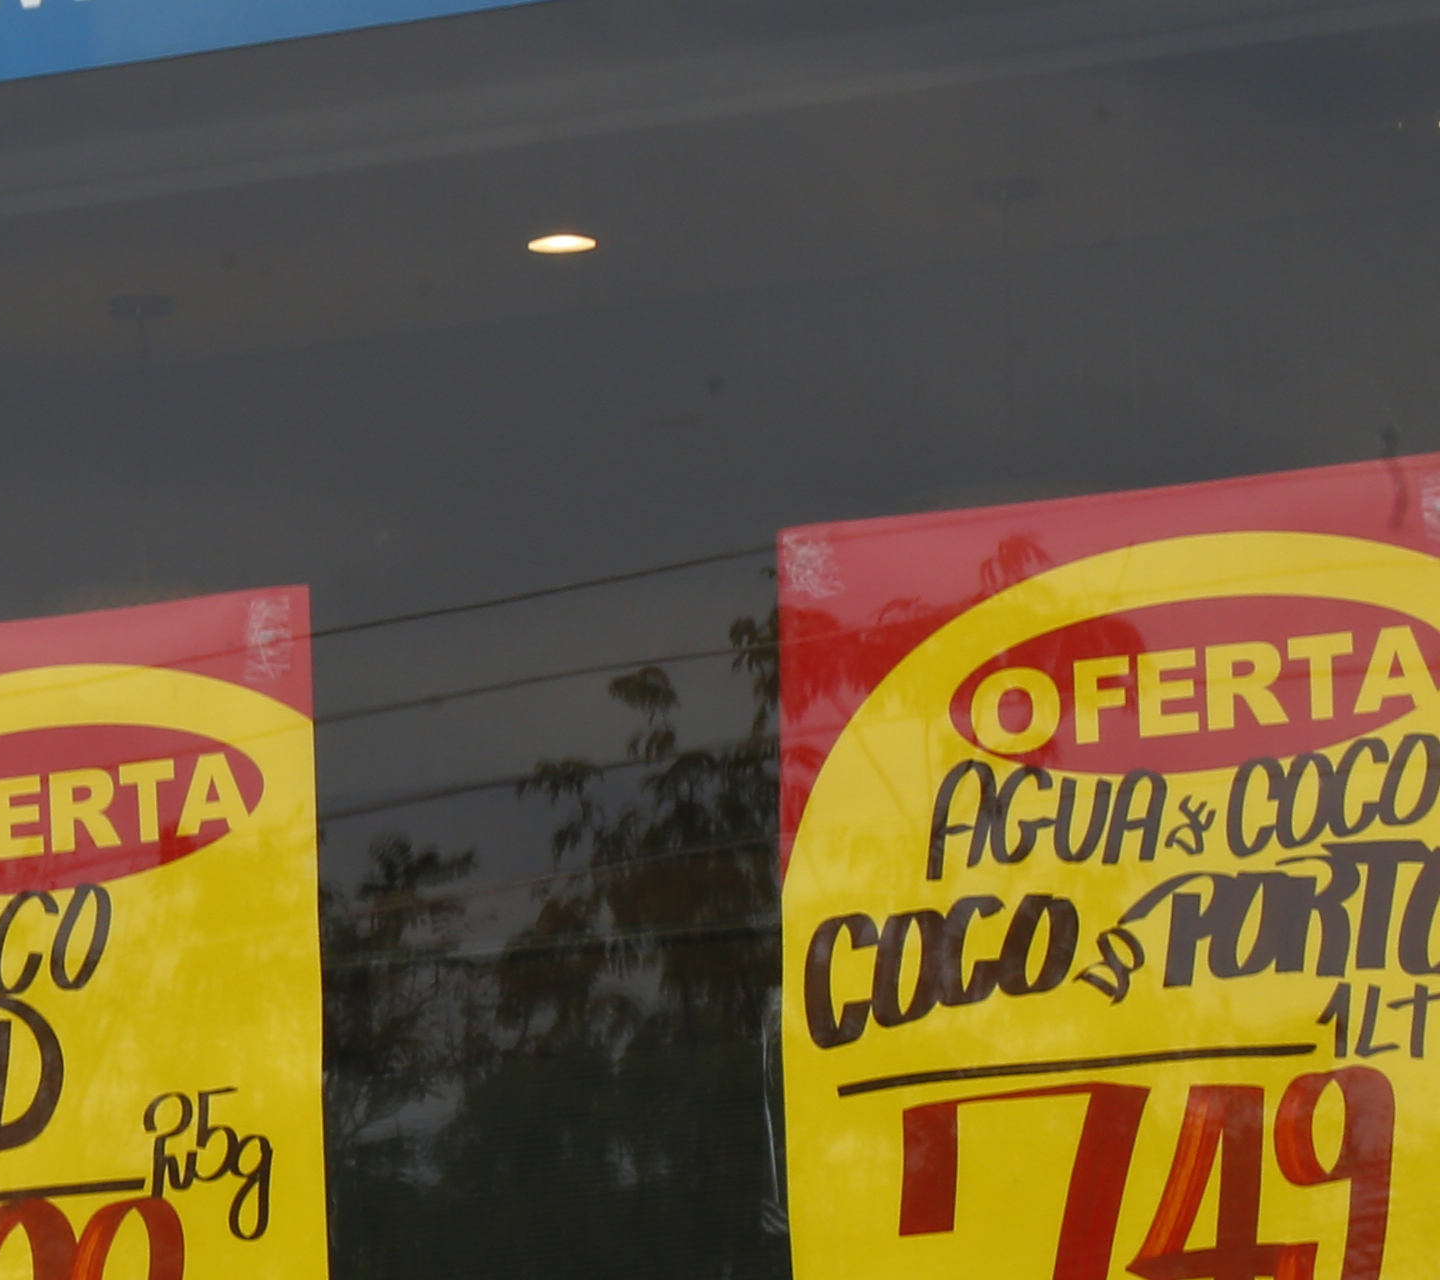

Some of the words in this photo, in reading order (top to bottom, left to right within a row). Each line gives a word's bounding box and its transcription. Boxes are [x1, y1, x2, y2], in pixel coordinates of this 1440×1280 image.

[971, 624, 1440, 756] OFERTA
[1226, 734, 1440, 858] COCO
[804, 893, 1077, 1050] COCO
